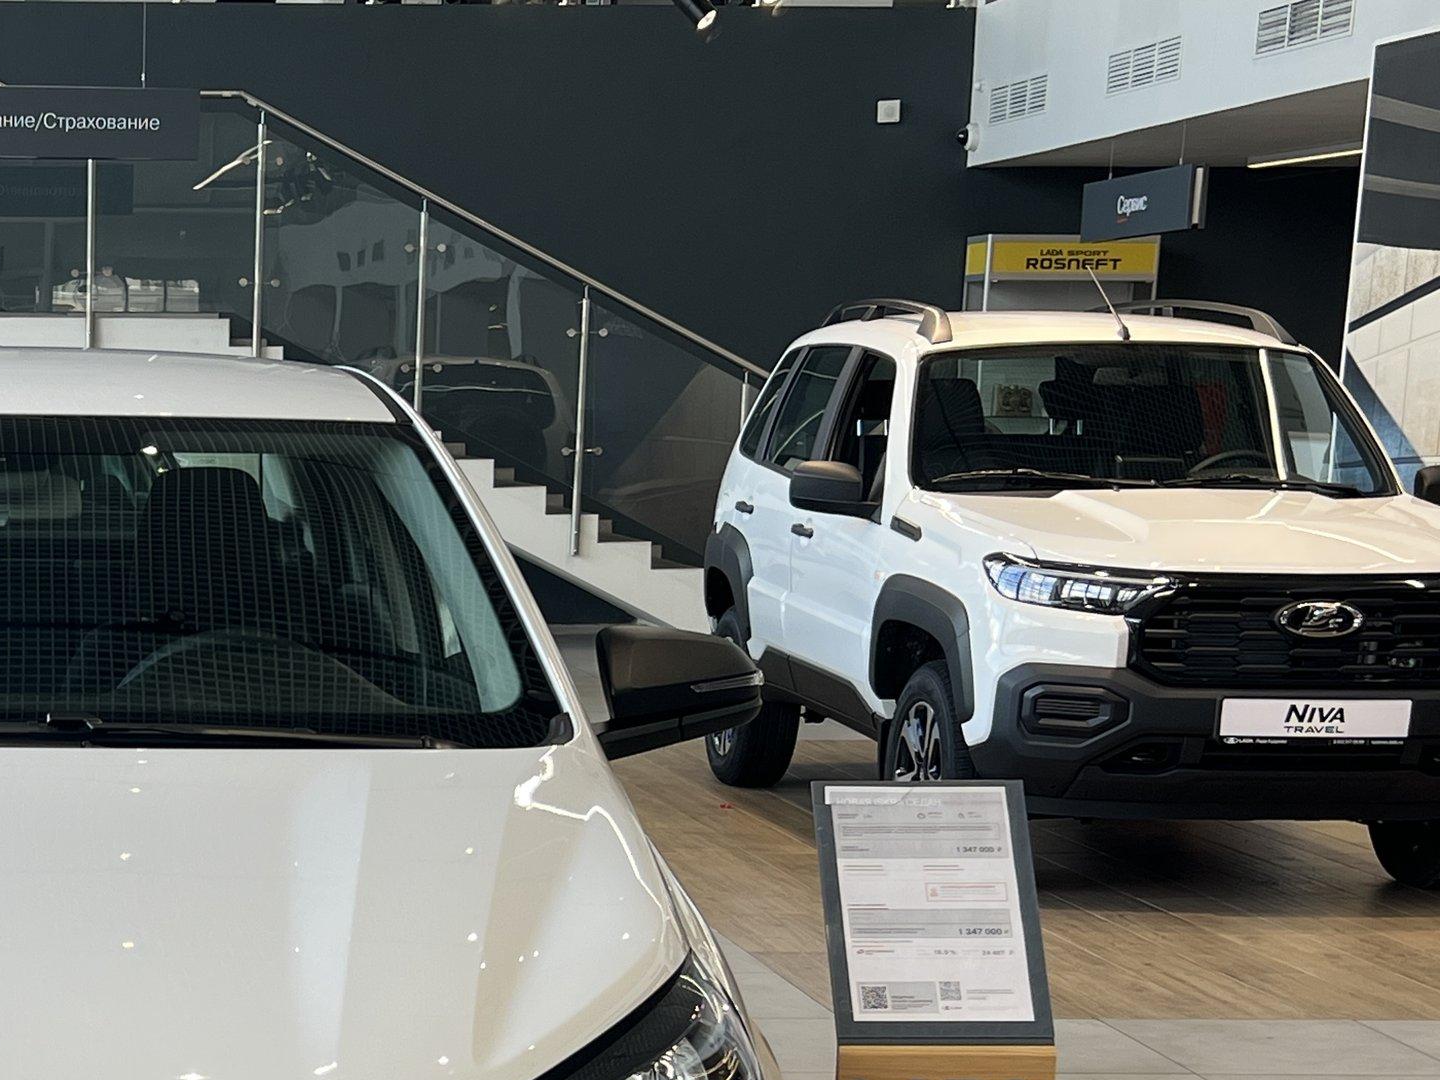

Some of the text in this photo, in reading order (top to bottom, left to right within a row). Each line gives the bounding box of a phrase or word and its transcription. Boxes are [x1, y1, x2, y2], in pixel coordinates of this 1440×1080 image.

[1117, 195, 1148, 217] Сервис
[1284, 704, 1346, 723] NIVA
[1283, 726, 1345, 734] TRAVEL
